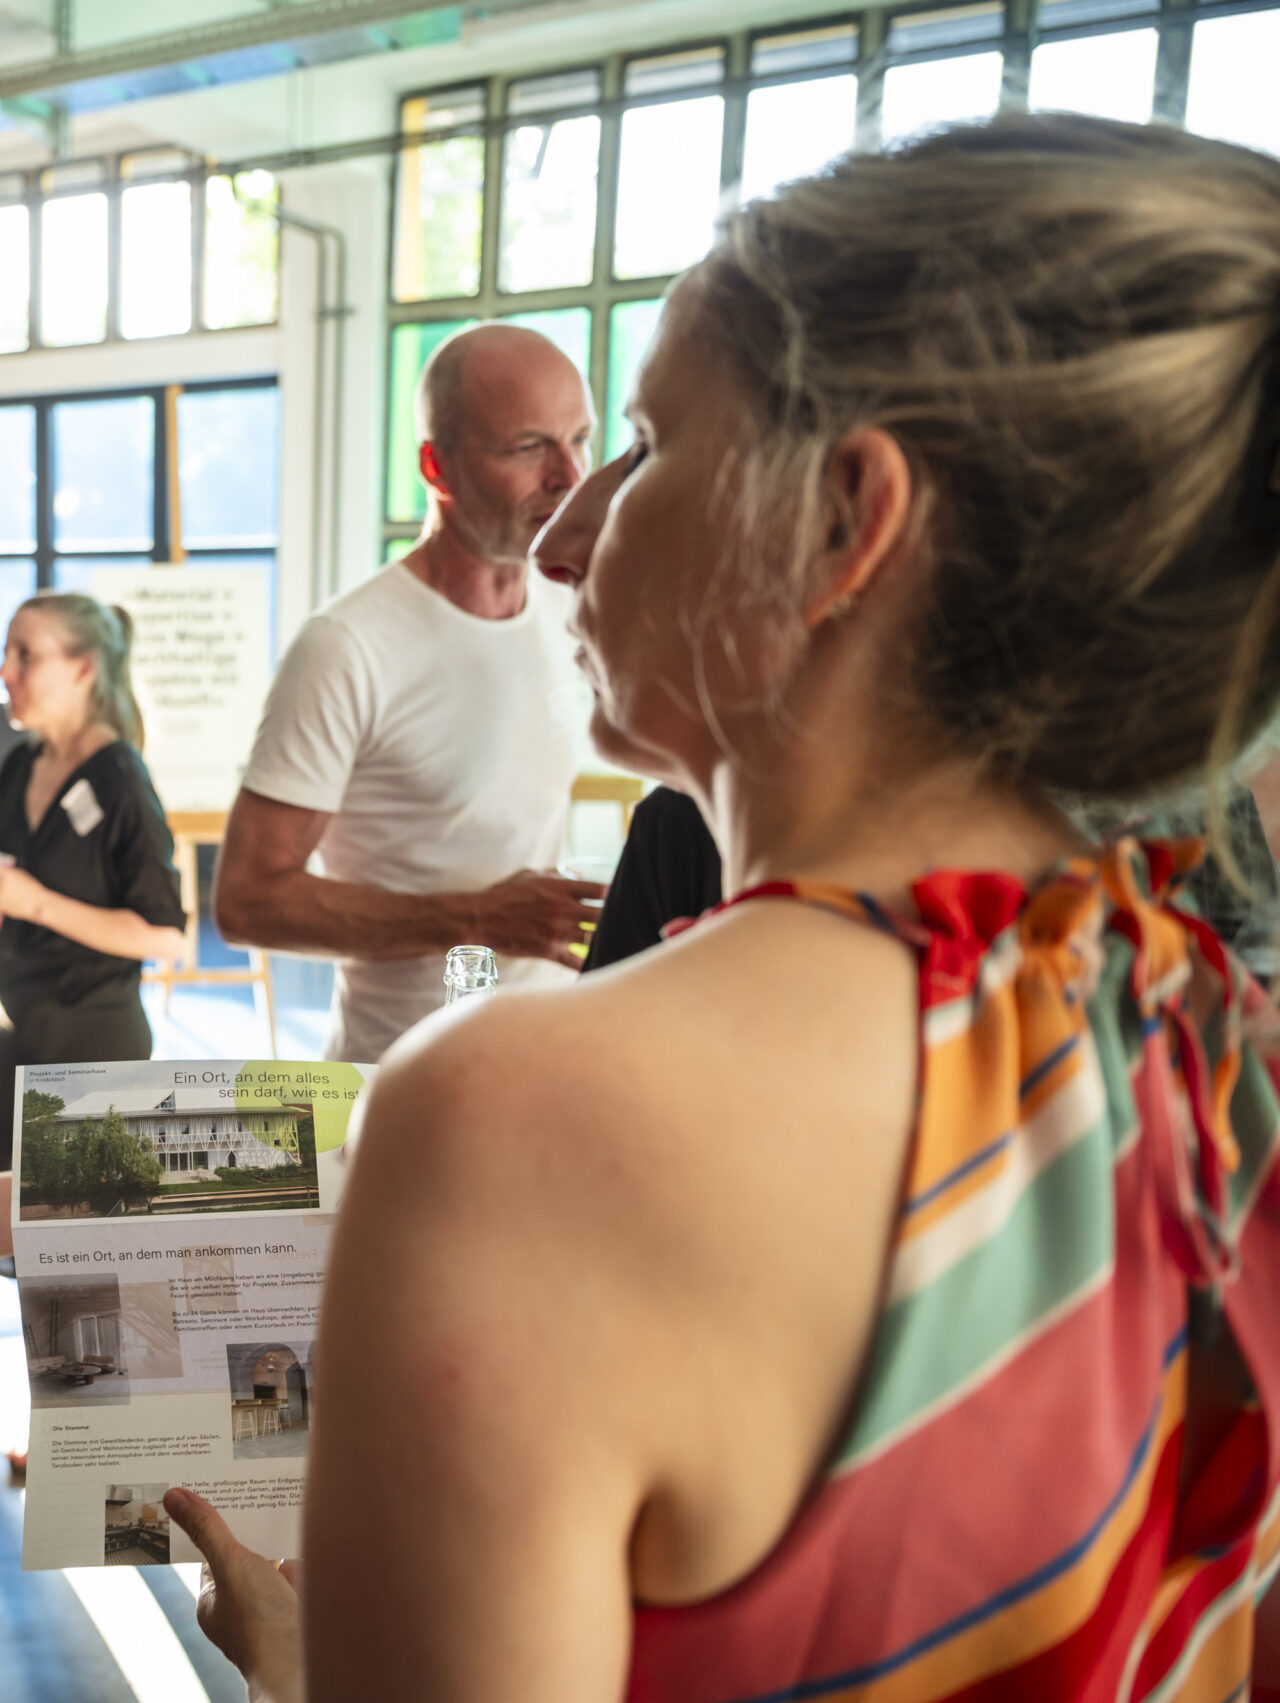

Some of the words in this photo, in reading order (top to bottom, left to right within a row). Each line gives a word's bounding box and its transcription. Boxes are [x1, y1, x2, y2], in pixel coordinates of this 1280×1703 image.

[174, 1072, 198, 1084] Ein
[202, 1071, 230, 1086] Ort,
[234, 1074, 253, 1084] an
[257, 1071, 291, 1084] dem
[296, 1072, 330, 1085] alles
[218, 1087, 250, 1098] sein
[254, 1086, 287, 1100] darf,
[291, 1087, 318, 1098] wie
[322, 1090, 340, 1100] es
[39, 1253, 54, 1264] Es
[56, 1252, 70, 1264] ist
[72, 1252, 90, 1263] ein
[93, 1250, 116, 1264] Ort,
[118, 1251, 133, 1262] an
[136, 1248, 162, 1260] dem
[166, 1248, 192, 1260] man
[194, 1244, 262, 1258] ankommen
[264, 1242, 297, 1254] kann.
